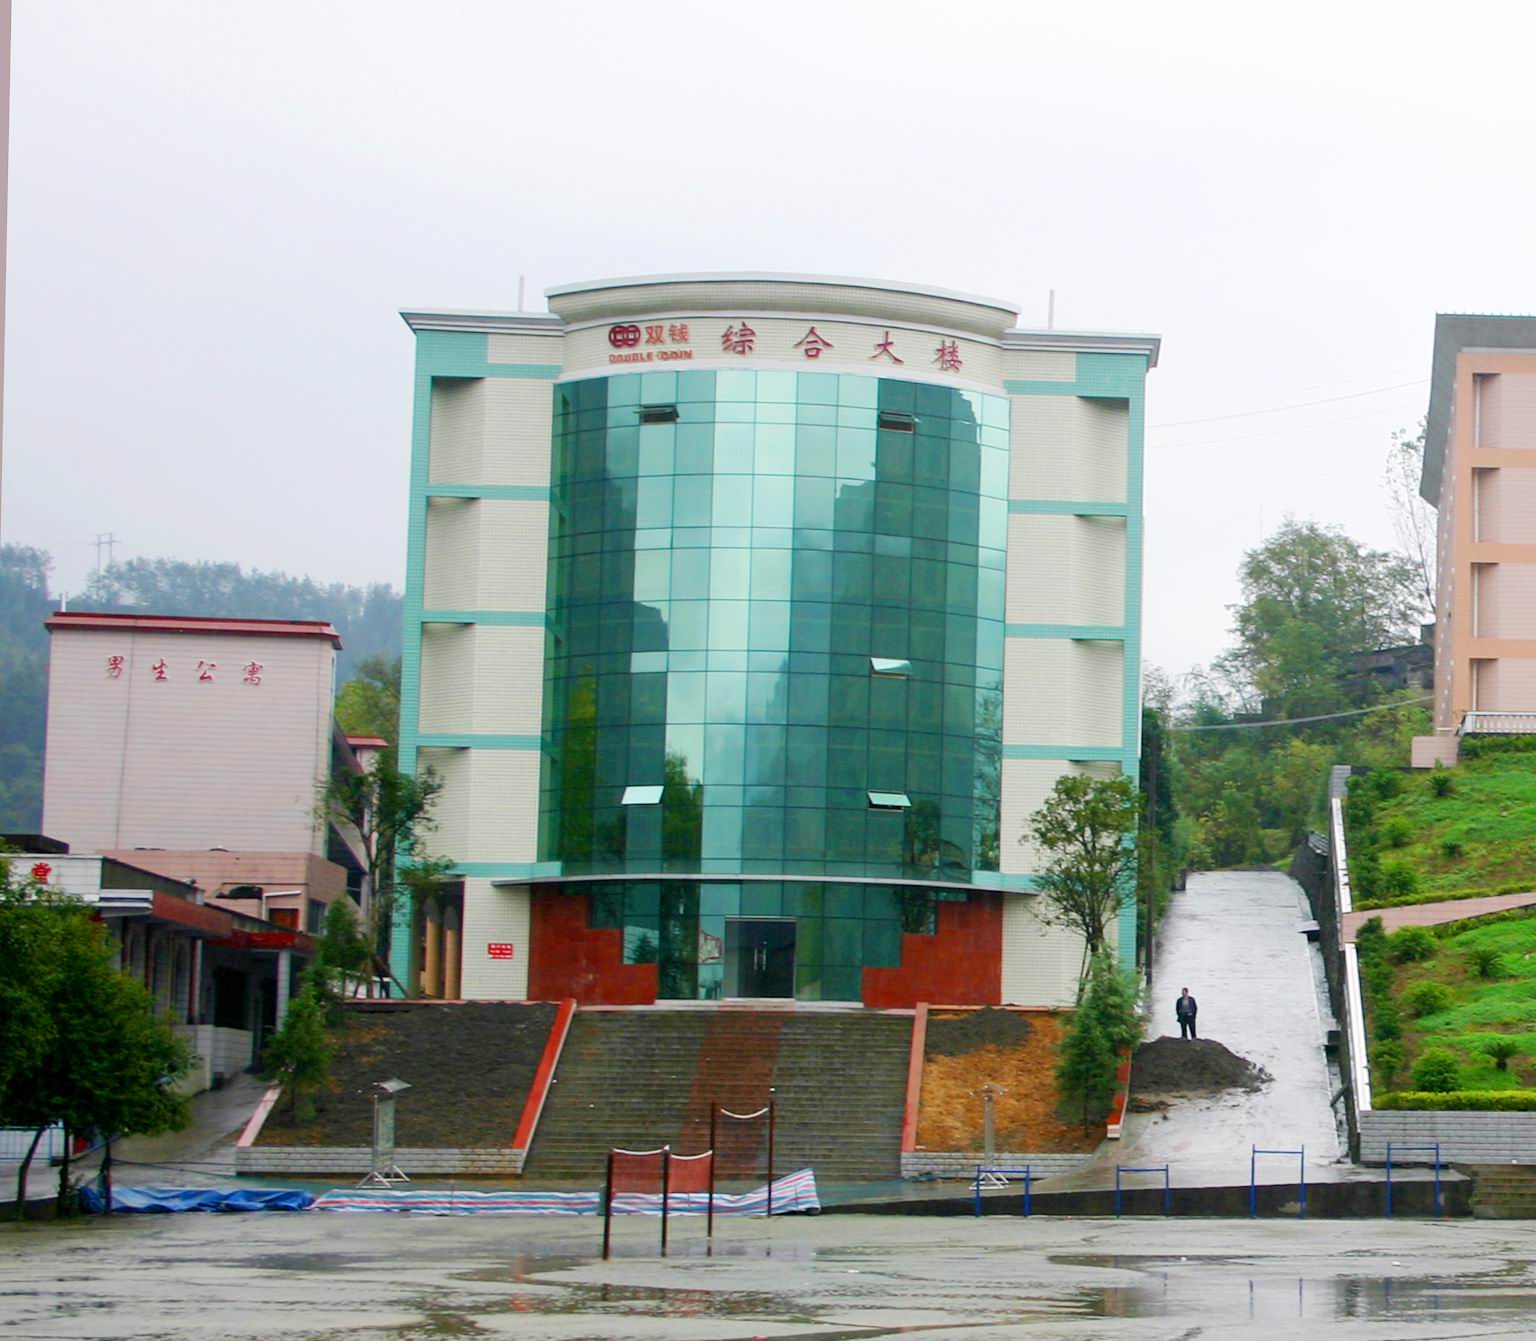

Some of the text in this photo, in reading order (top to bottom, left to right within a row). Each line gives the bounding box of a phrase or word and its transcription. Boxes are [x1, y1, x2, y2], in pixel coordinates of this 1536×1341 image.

[645, 322, 690, 345] 双钱
[721, 320, 964, 373] 综合大楼
[608, 351, 654, 364] DOUBLE
[105, 654, 265, 687] 男生公寓
